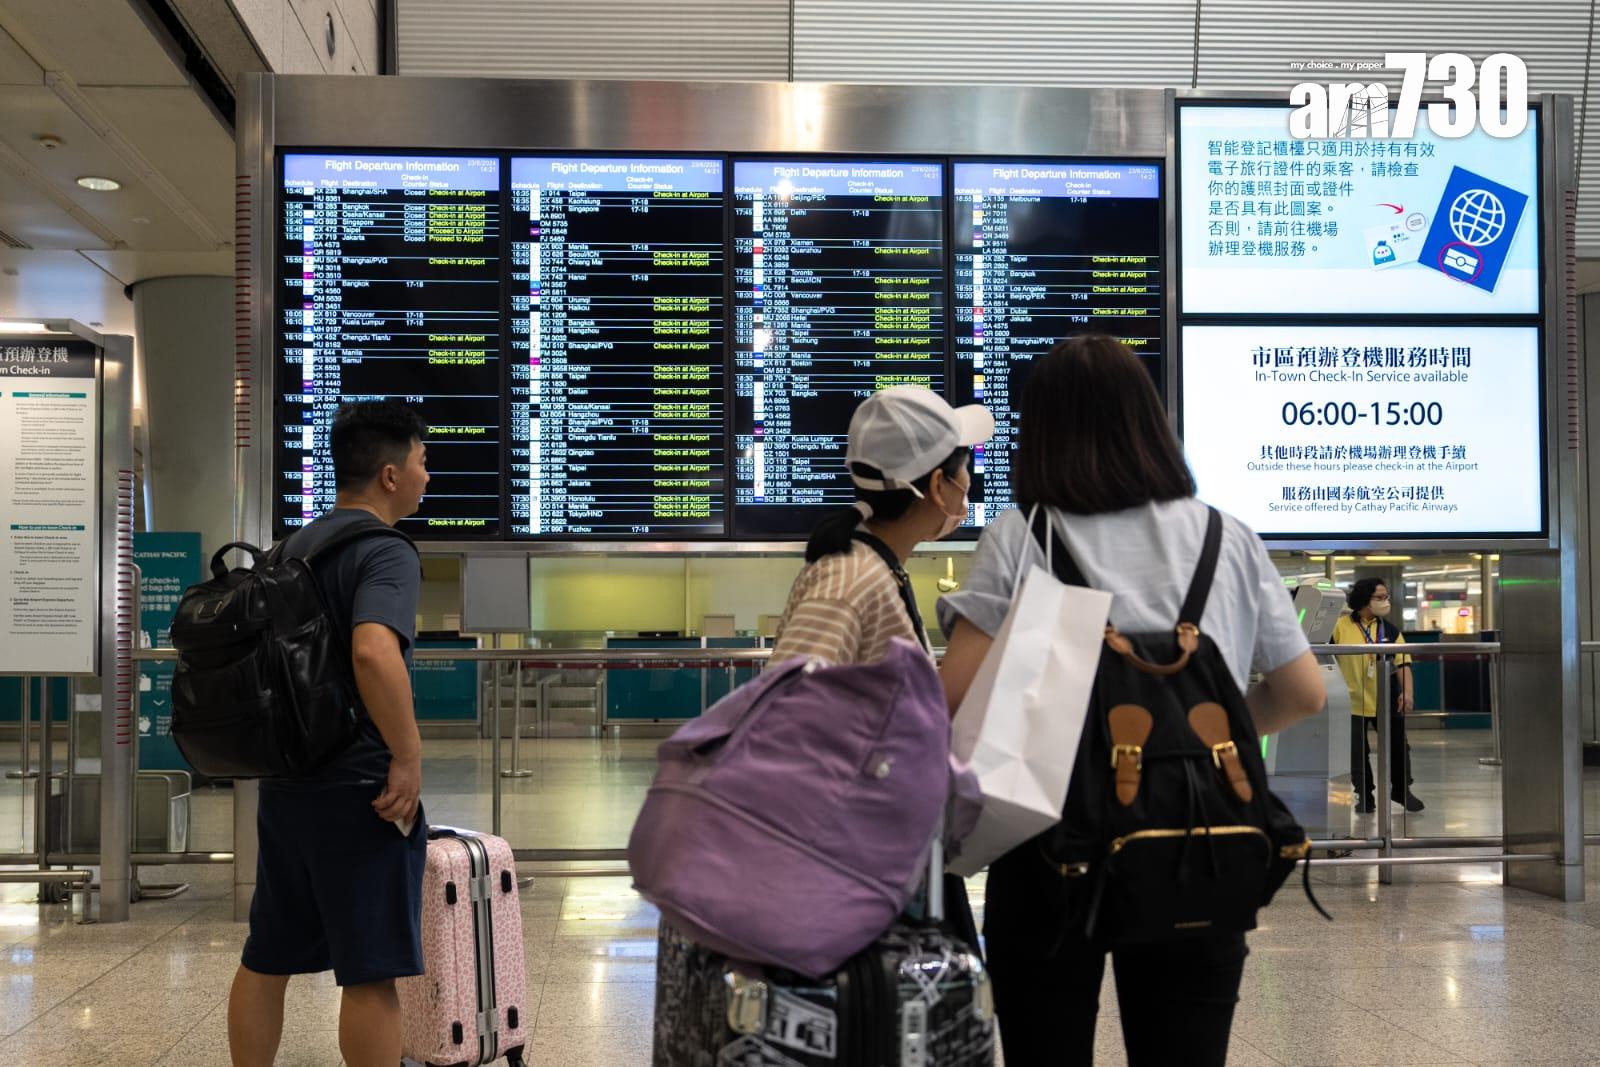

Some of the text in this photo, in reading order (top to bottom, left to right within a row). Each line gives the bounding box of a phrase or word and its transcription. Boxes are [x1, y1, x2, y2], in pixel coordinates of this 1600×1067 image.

[326, 160, 459, 171] Flight Departure Information
[552, 163, 683, 174] Flight Departure Information
[774, 168, 903, 178] Flight Departure Information
[994, 169, 1120, 179] Flight Departure Information
[1208, 181, 1354, 196] 你的護照封面或證件
[1208, 201, 1333, 216] 是否具有此圖案。
[1208, 241, 1318, 257] 辦理登機服務。
[0, 346, 69, 363] 預辦登機
[1251, 346, 1471, 368] 市區預辦登機服務時間
[10, 365, 50, 374] Check-in
[1256, 370, 1468, 382] In-Town Check-In Service available
[1282, 402, 1442, 426] 06:00-15:00
[1260, 445, 1466, 460] 其他時段請於機場辦理登機手續
[1247, 462, 1478, 472] Outside these hours please check-in at the Airport
[1282, 486, 1444, 501] 服務由國泰航空公司提供
[1269, 502, 1458, 513] Service offered by Cathay Pacific Airways
